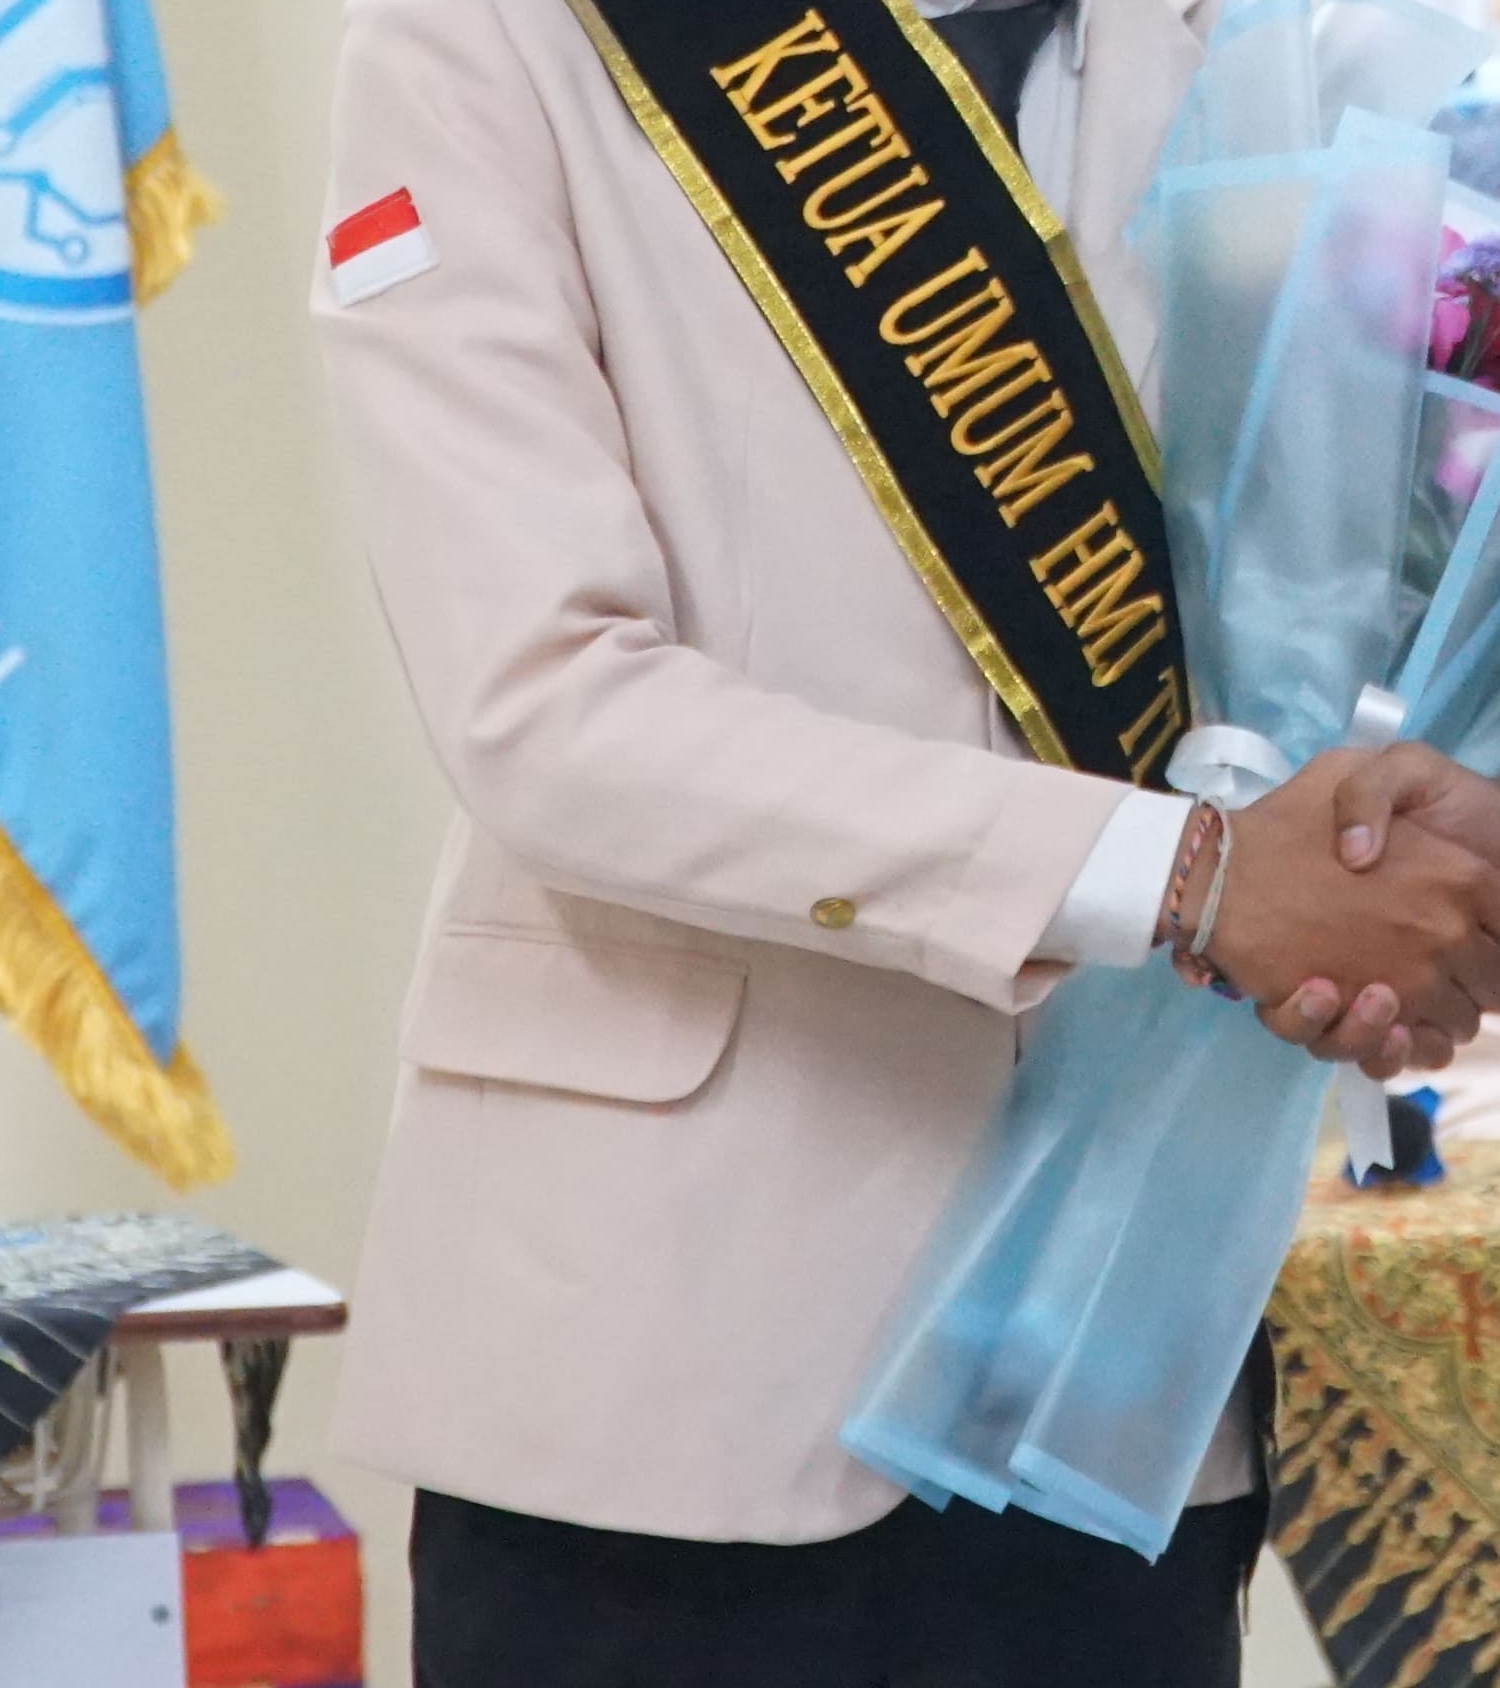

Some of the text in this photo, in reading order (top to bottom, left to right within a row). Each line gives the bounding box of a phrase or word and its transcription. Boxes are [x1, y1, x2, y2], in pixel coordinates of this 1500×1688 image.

[710, 7, 946, 289] KETUA
[877, 247, 1096, 530] UMUM
[1028, 501, 1171, 689] HMJ
